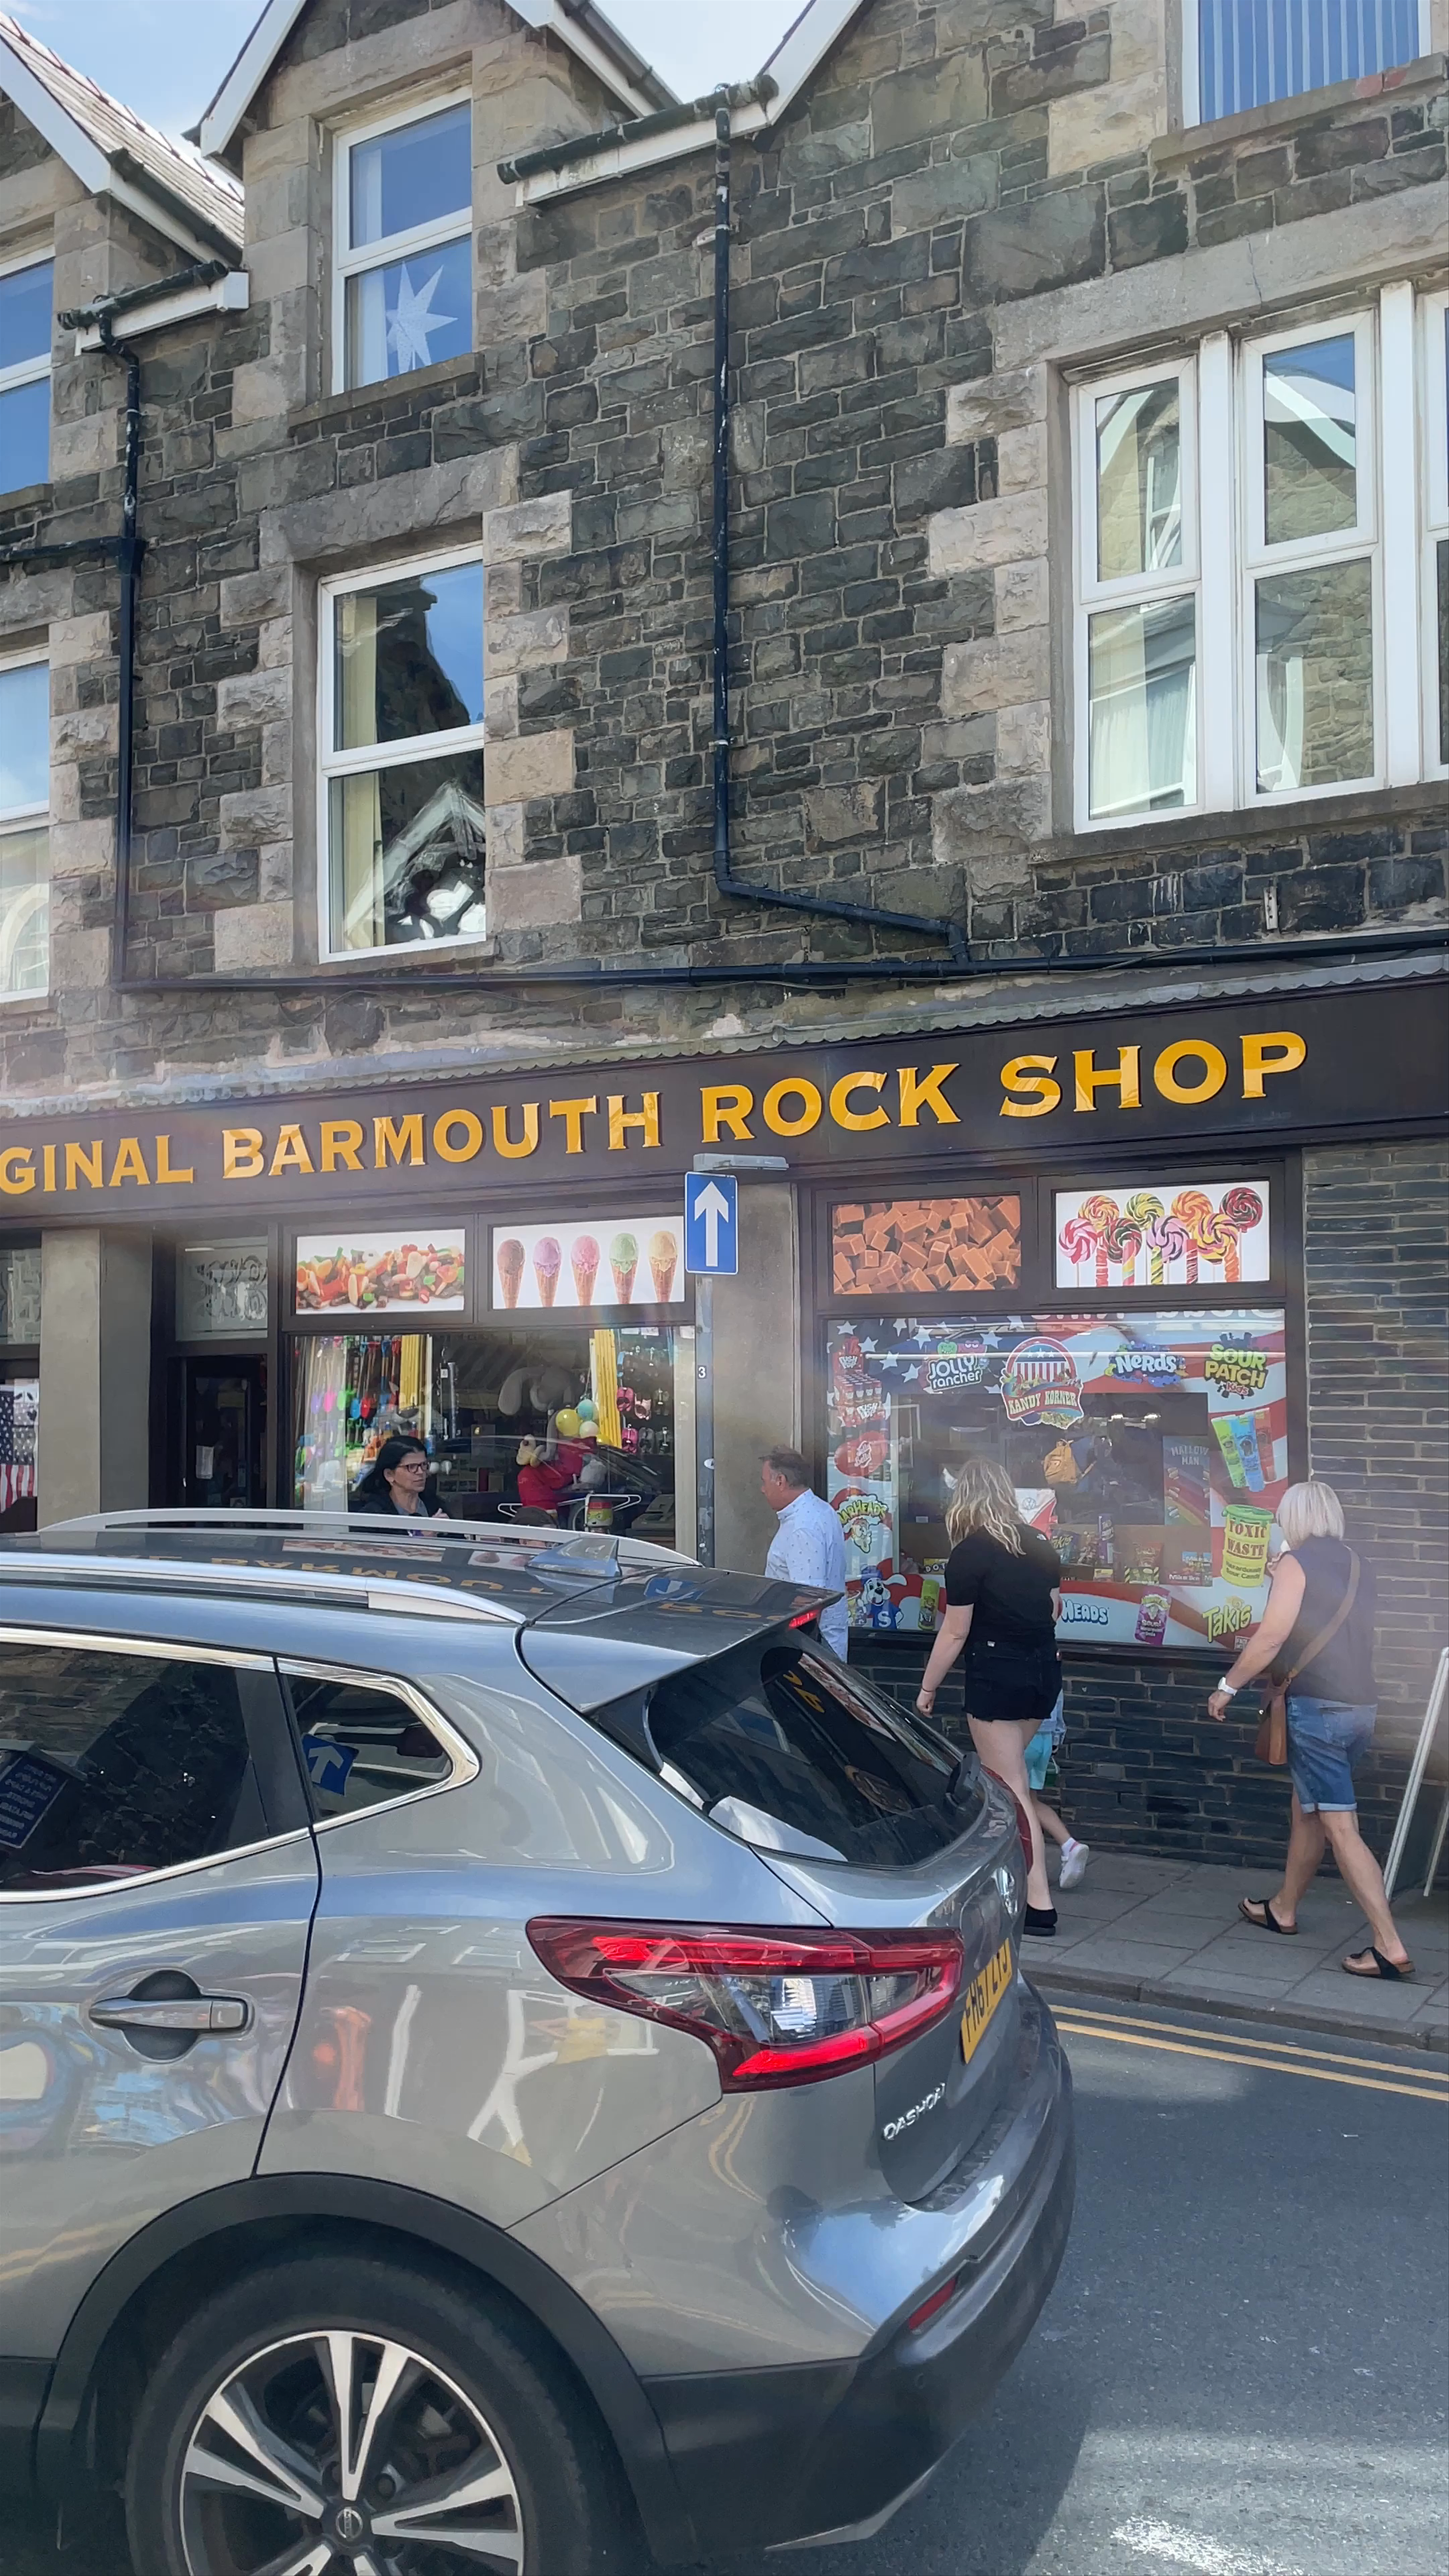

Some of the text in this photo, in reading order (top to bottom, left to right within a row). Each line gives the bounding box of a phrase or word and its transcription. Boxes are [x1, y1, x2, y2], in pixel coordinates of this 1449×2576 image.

[222, 1090, 663, 1179] BARMOUTH
[700, 1063, 961, 1143] ROCK
[999, 1030, 1308, 1118] SHOP
[929, 1355, 975, 1380] JOLLY
[1210, 1344, 1266, 1370] SOUR
[698, 1366, 706, 1378] 3
[933, 1370, 981, 1389] rancher
[1206, 1361, 1266, 1388] PATCH
[1008, 1389, 1077, 1415] KANDY KORNER
[1170, 1445, 1209, 1456] MALLOW
[1181, 1456, 1200, 1465] MAN
[877, 1610, 891, 1627] S
[1202, 1604, 1252, 1643] Takis
